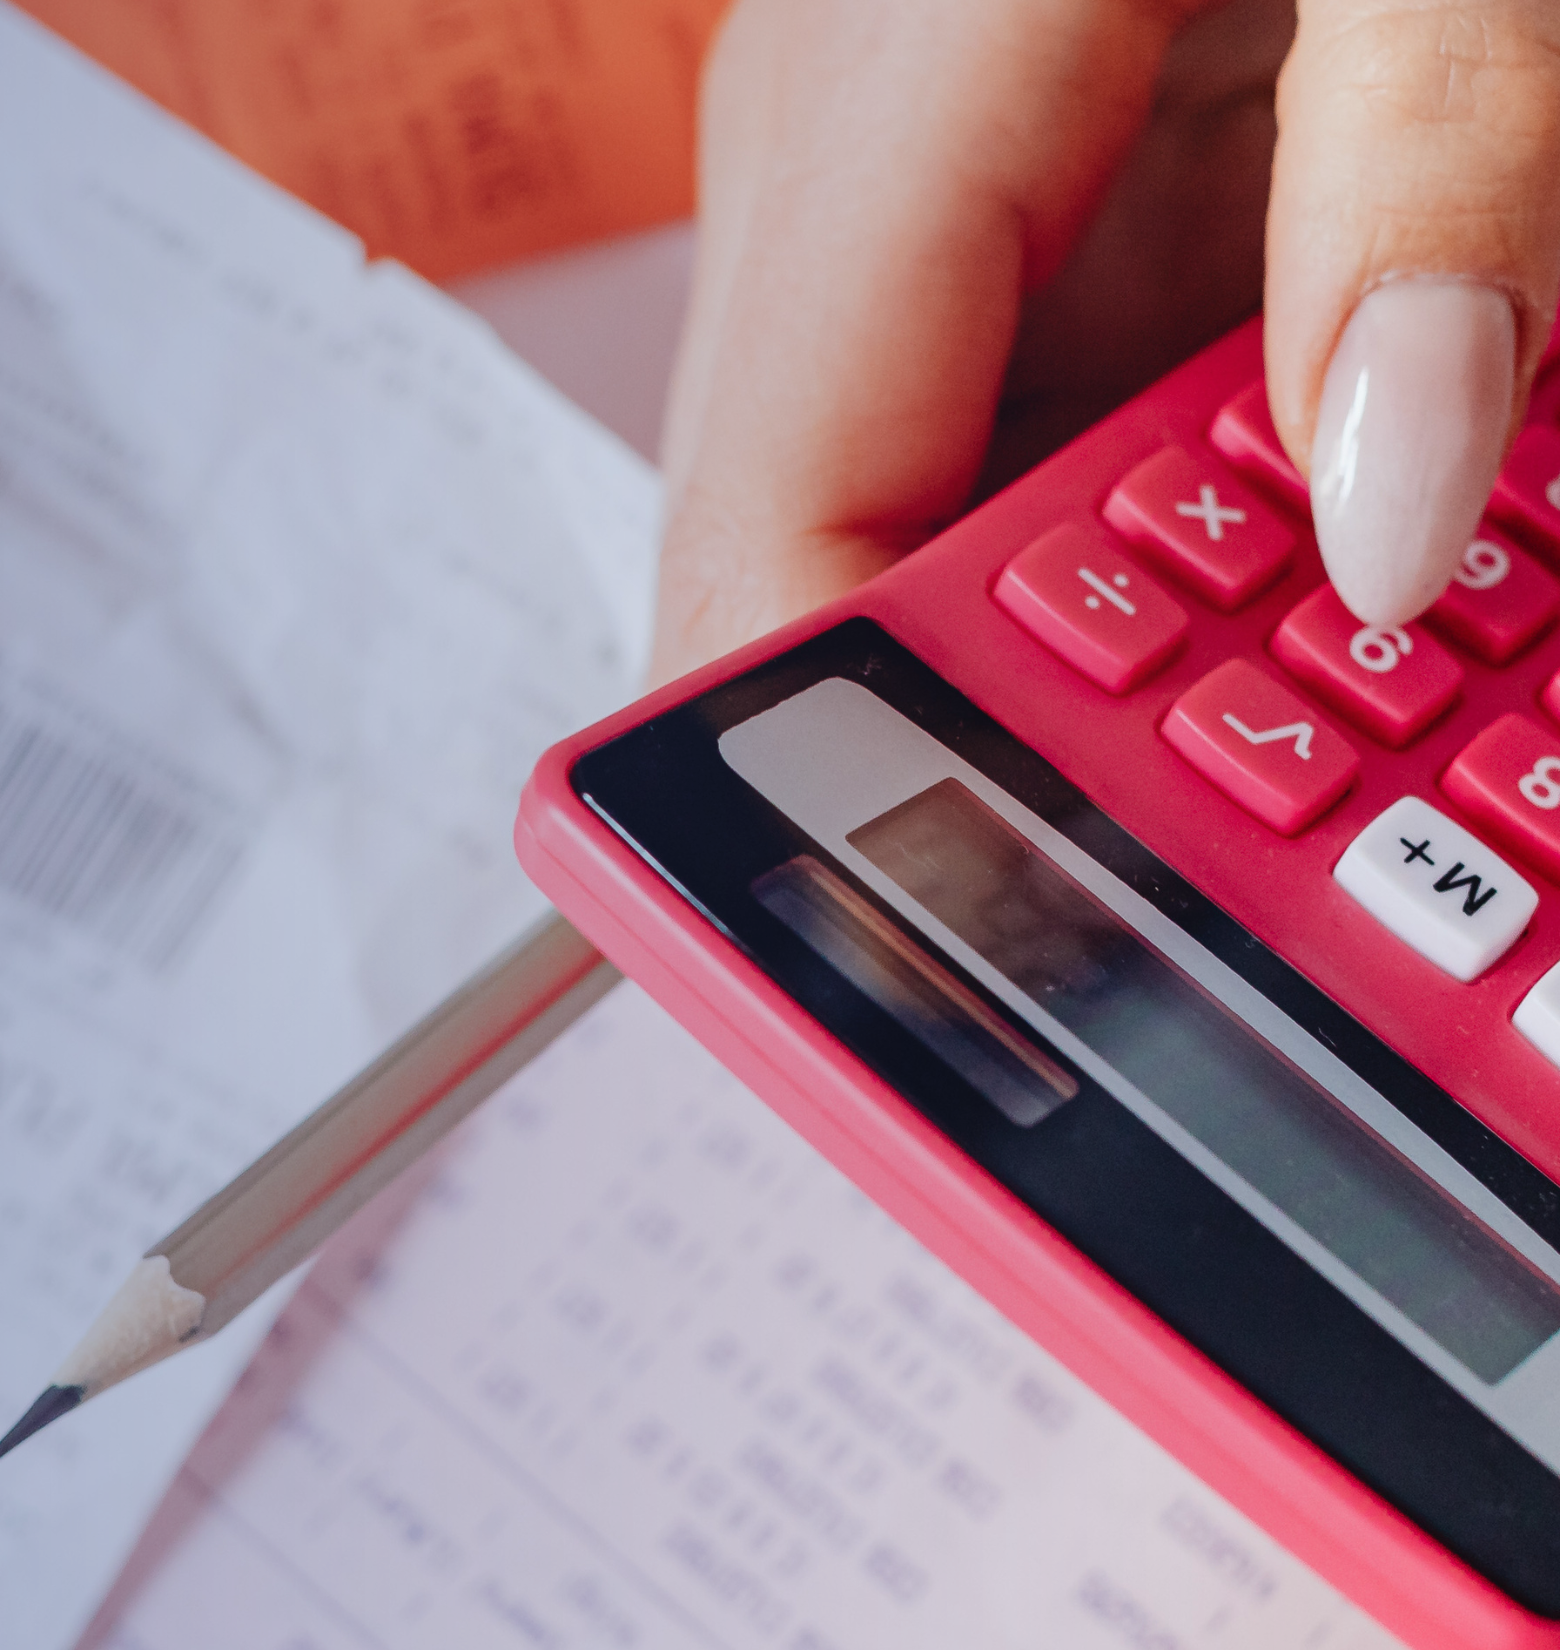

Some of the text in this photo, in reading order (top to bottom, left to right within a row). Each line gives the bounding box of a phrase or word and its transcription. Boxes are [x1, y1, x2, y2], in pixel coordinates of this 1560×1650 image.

[1455, 538, 1511, 590] 6
[1349, 624, 1413, 674] 9
[1400, 837, 1497, 917] M+
